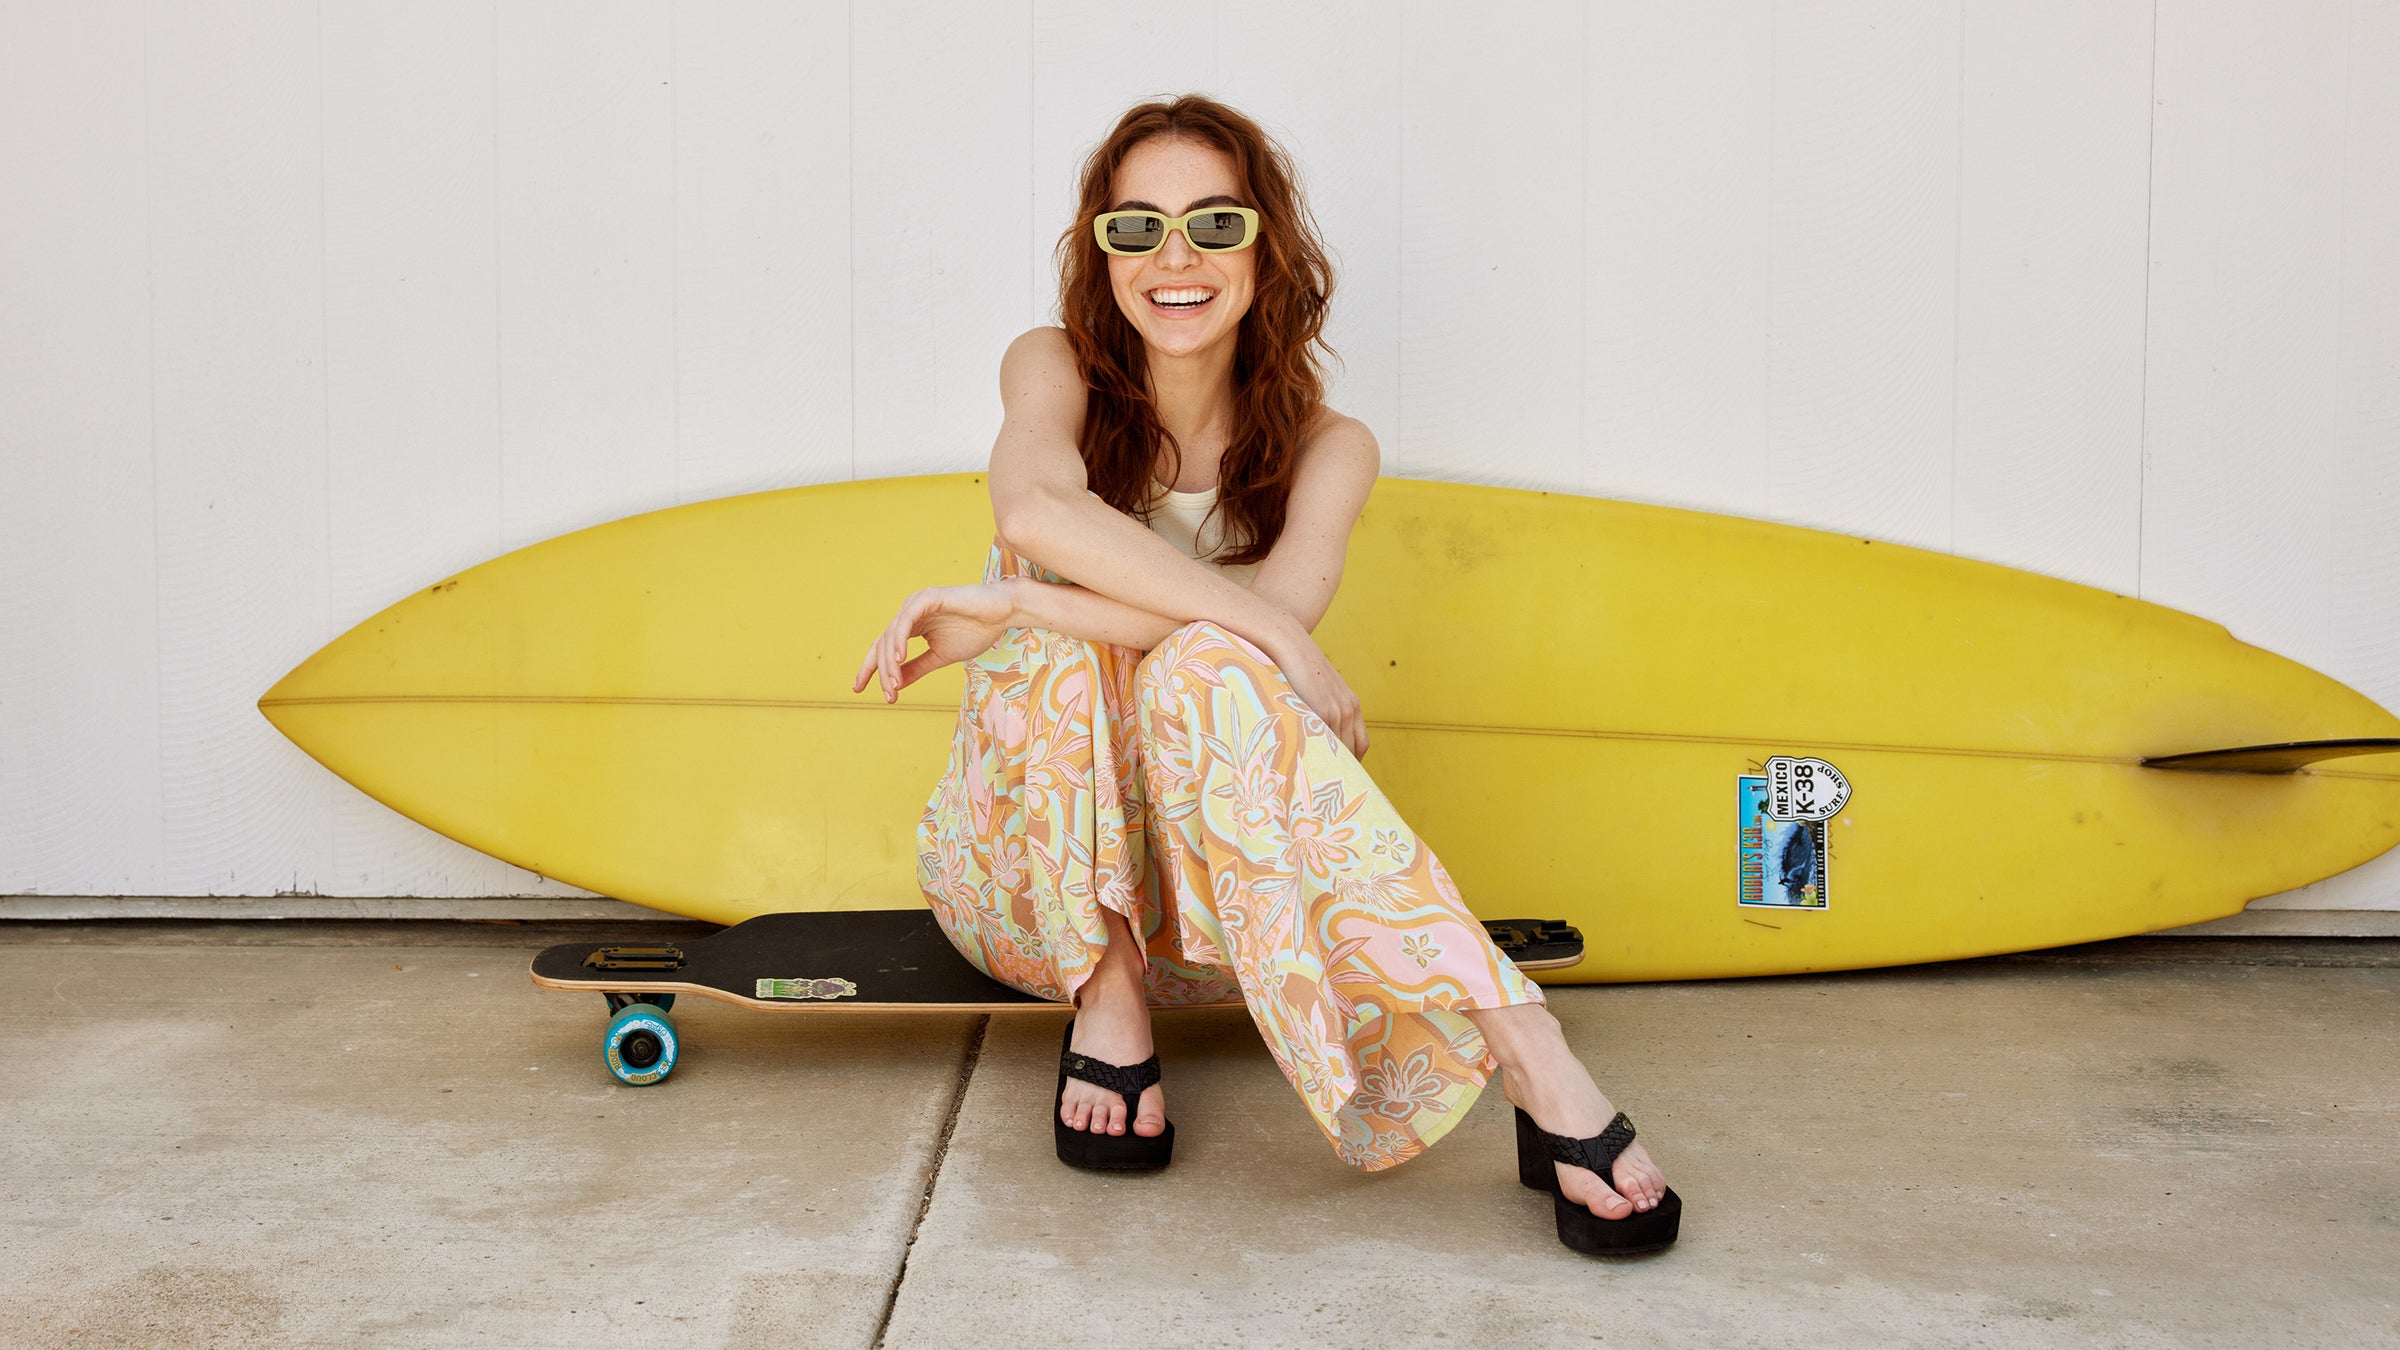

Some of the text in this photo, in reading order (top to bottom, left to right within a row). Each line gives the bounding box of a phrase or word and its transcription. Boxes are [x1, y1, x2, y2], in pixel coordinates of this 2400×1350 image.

[1775, 762, 1789, 815] MEXICO
[1794, 764, 1815, 814] K-38
[1817, 765, 1844, 789] SHOP
[1818, 791, 1844, 815] SURF
[630, 1072, 657, 1082] CLOUD
